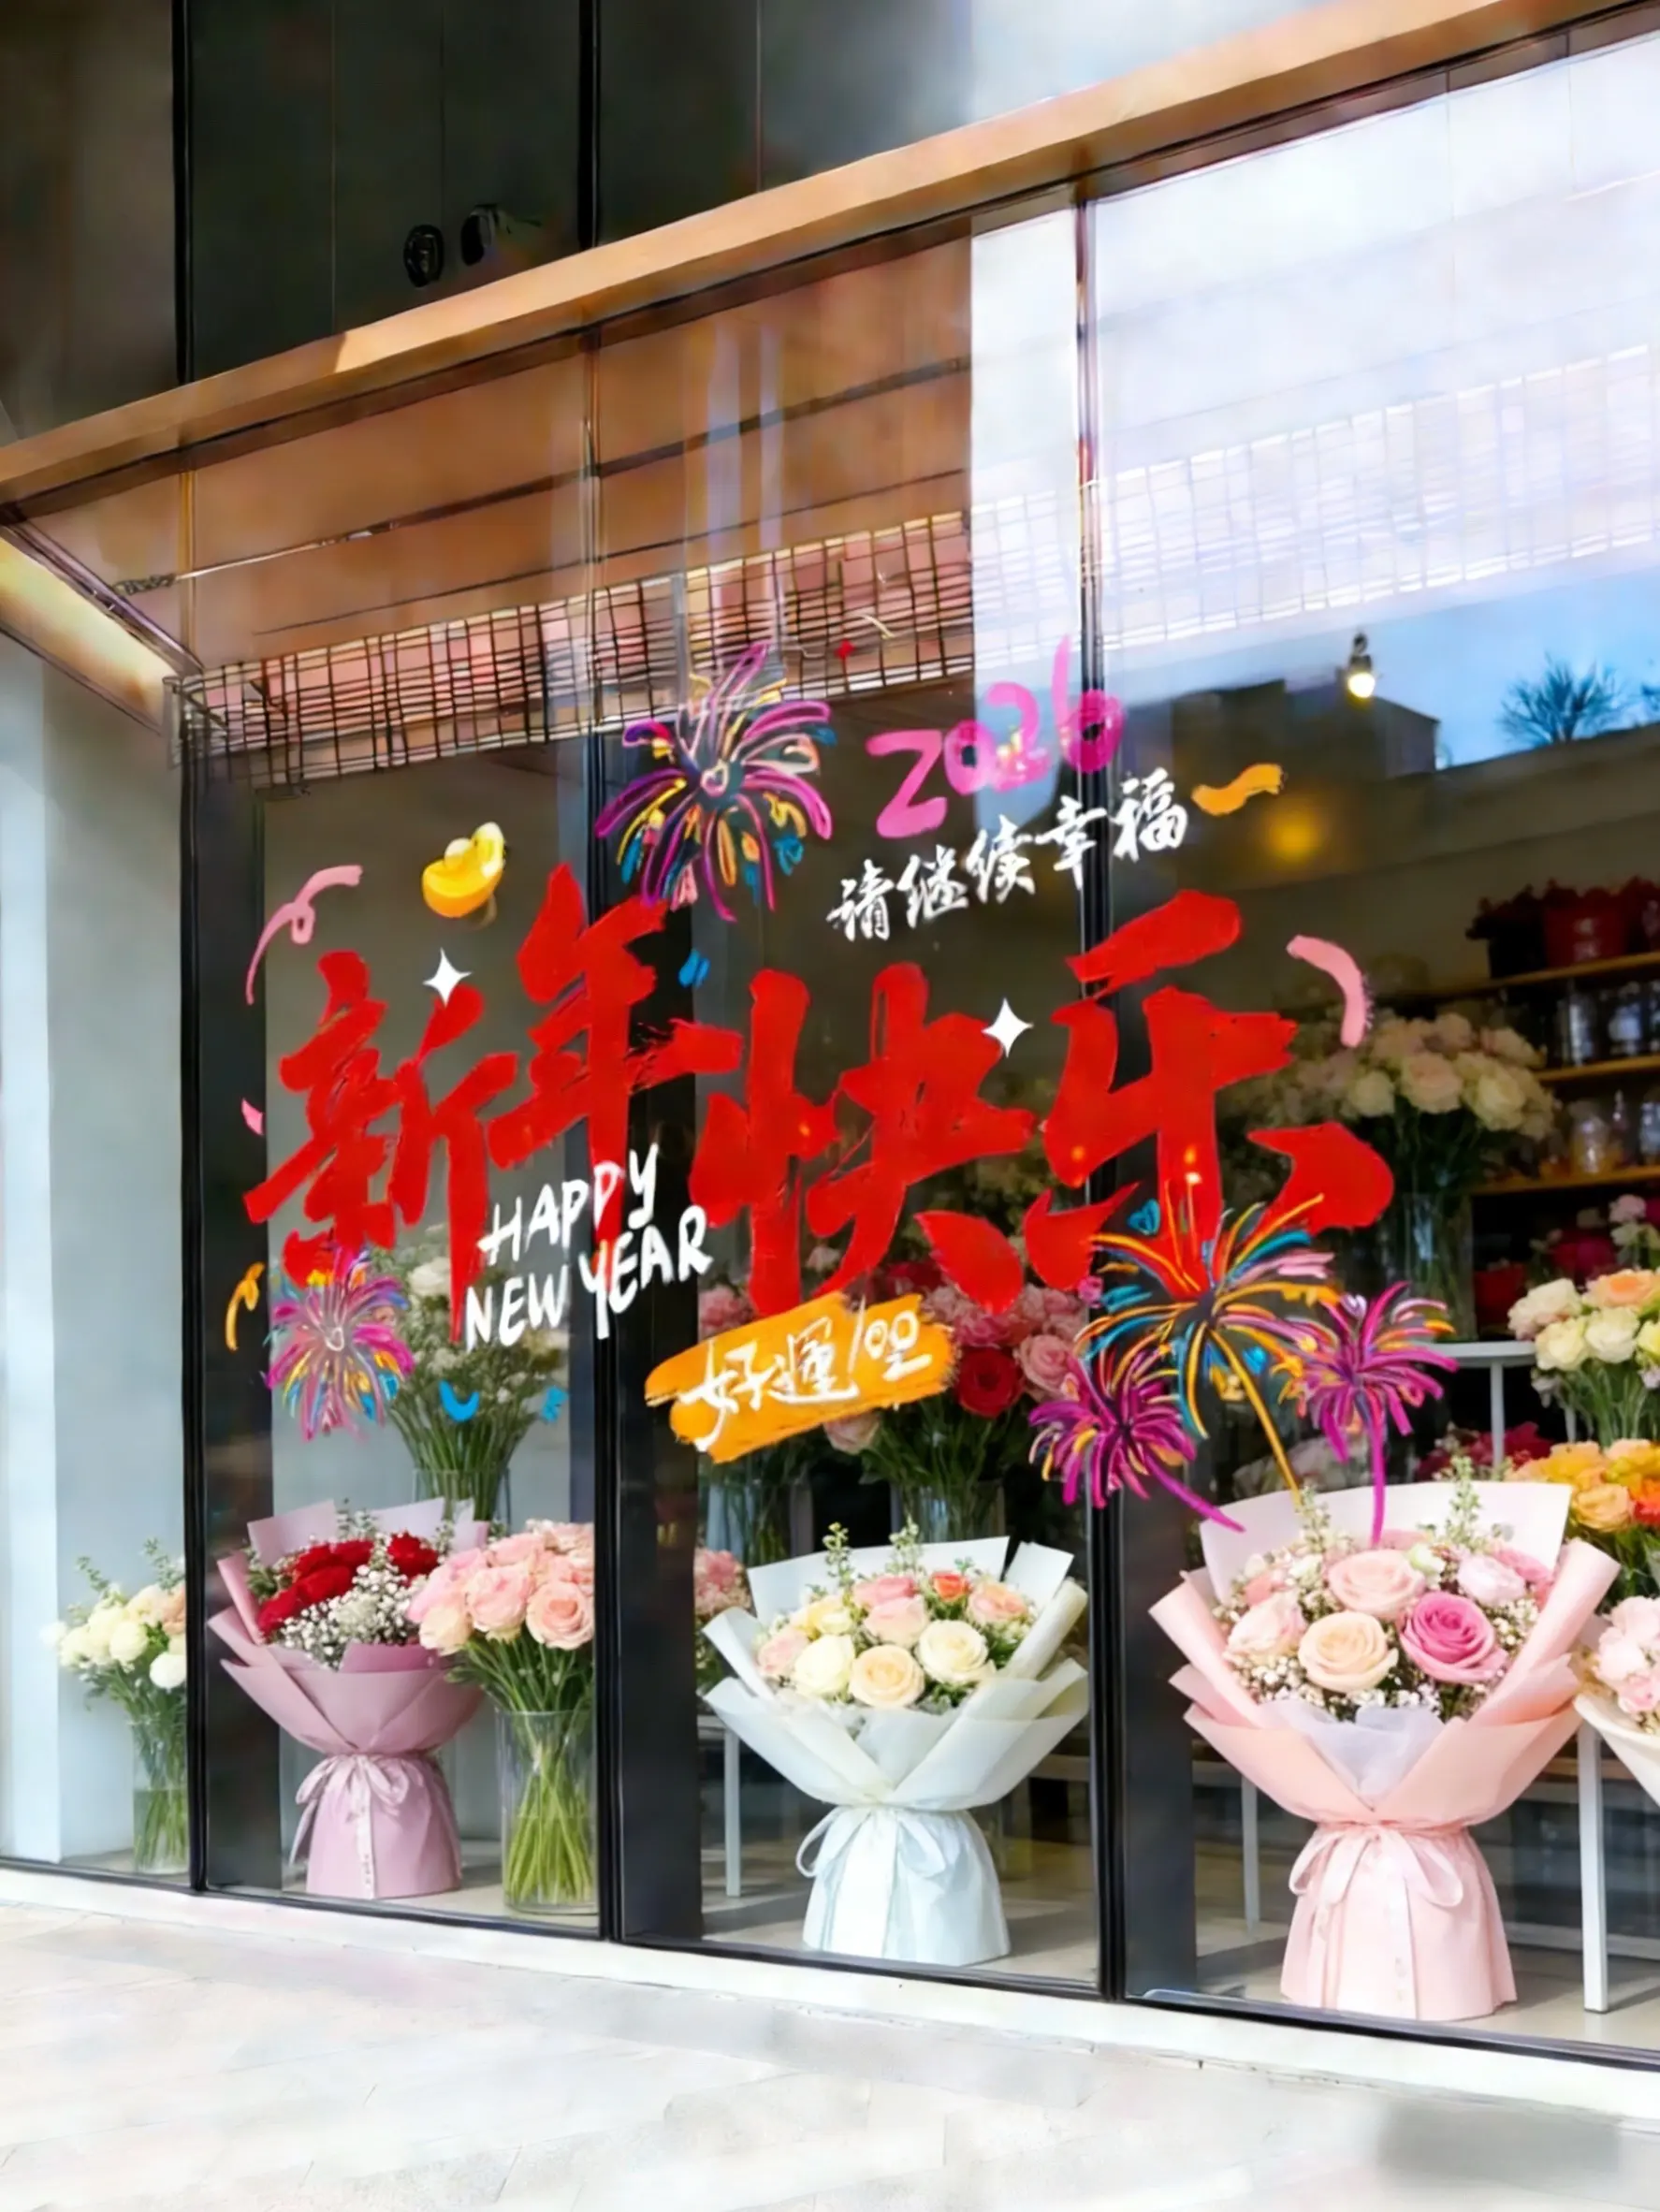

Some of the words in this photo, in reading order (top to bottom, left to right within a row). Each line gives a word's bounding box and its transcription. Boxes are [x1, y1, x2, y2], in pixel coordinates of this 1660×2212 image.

[826, 766, 1187, 941] 请继续幸福
[243, 862, 1395, 1345] 新年快乐
[465, 1264, 569, 1354] NEW
[578, 1205, 714, 1340] YEAR
